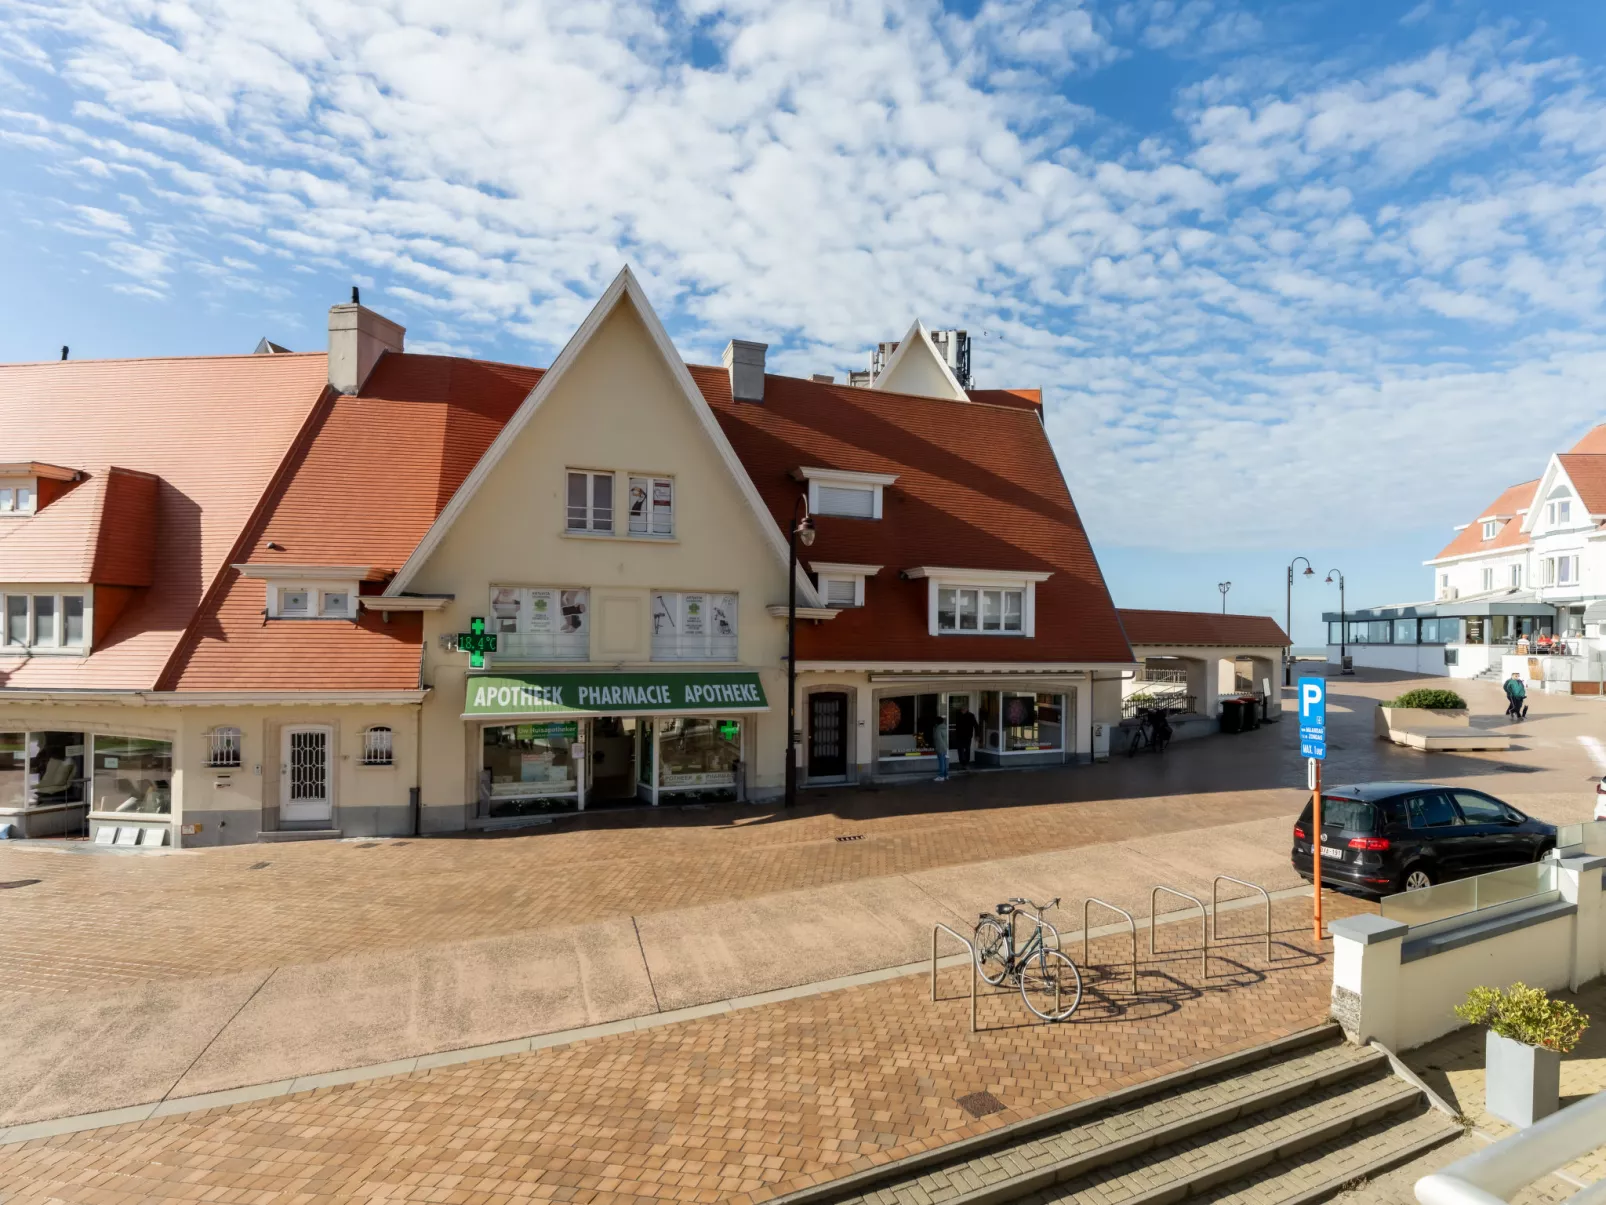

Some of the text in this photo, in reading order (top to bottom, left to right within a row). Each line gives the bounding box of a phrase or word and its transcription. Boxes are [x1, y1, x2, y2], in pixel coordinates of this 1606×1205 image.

[473, 683, 760, 707] APOTHEEK PHARMACIE APOTHEKE
[1303, 684, 1322, 717] P
